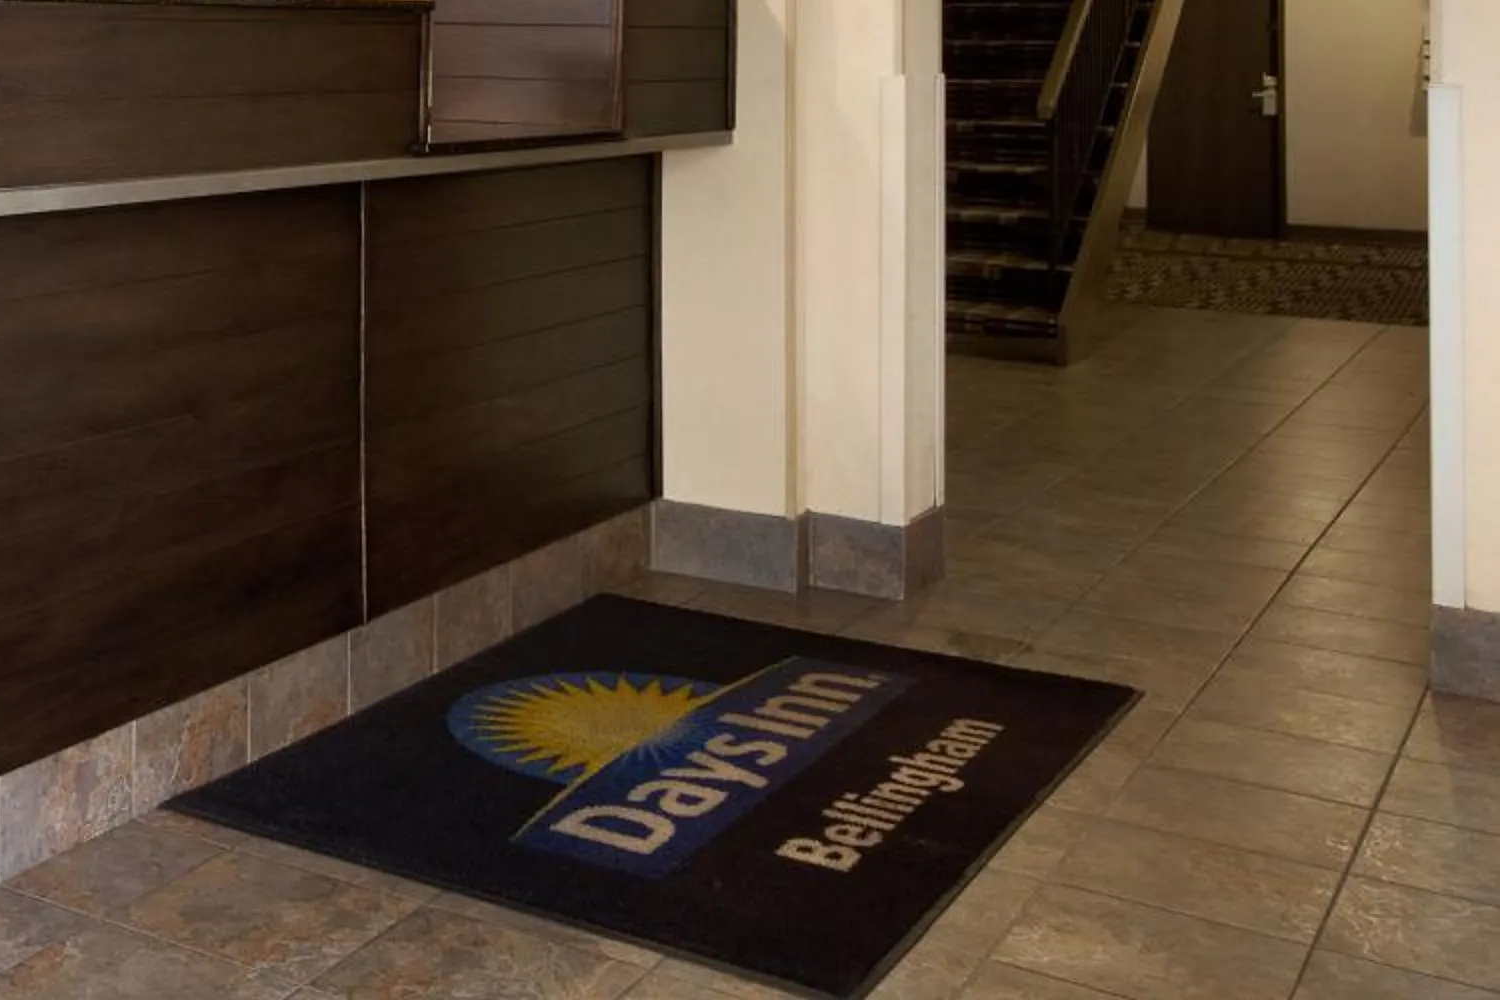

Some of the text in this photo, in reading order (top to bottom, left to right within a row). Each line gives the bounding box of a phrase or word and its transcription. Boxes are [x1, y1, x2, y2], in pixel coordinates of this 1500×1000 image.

[549, 672, 880, 855] Days Inn
[775, 717, 1005, 873] Bellingham
